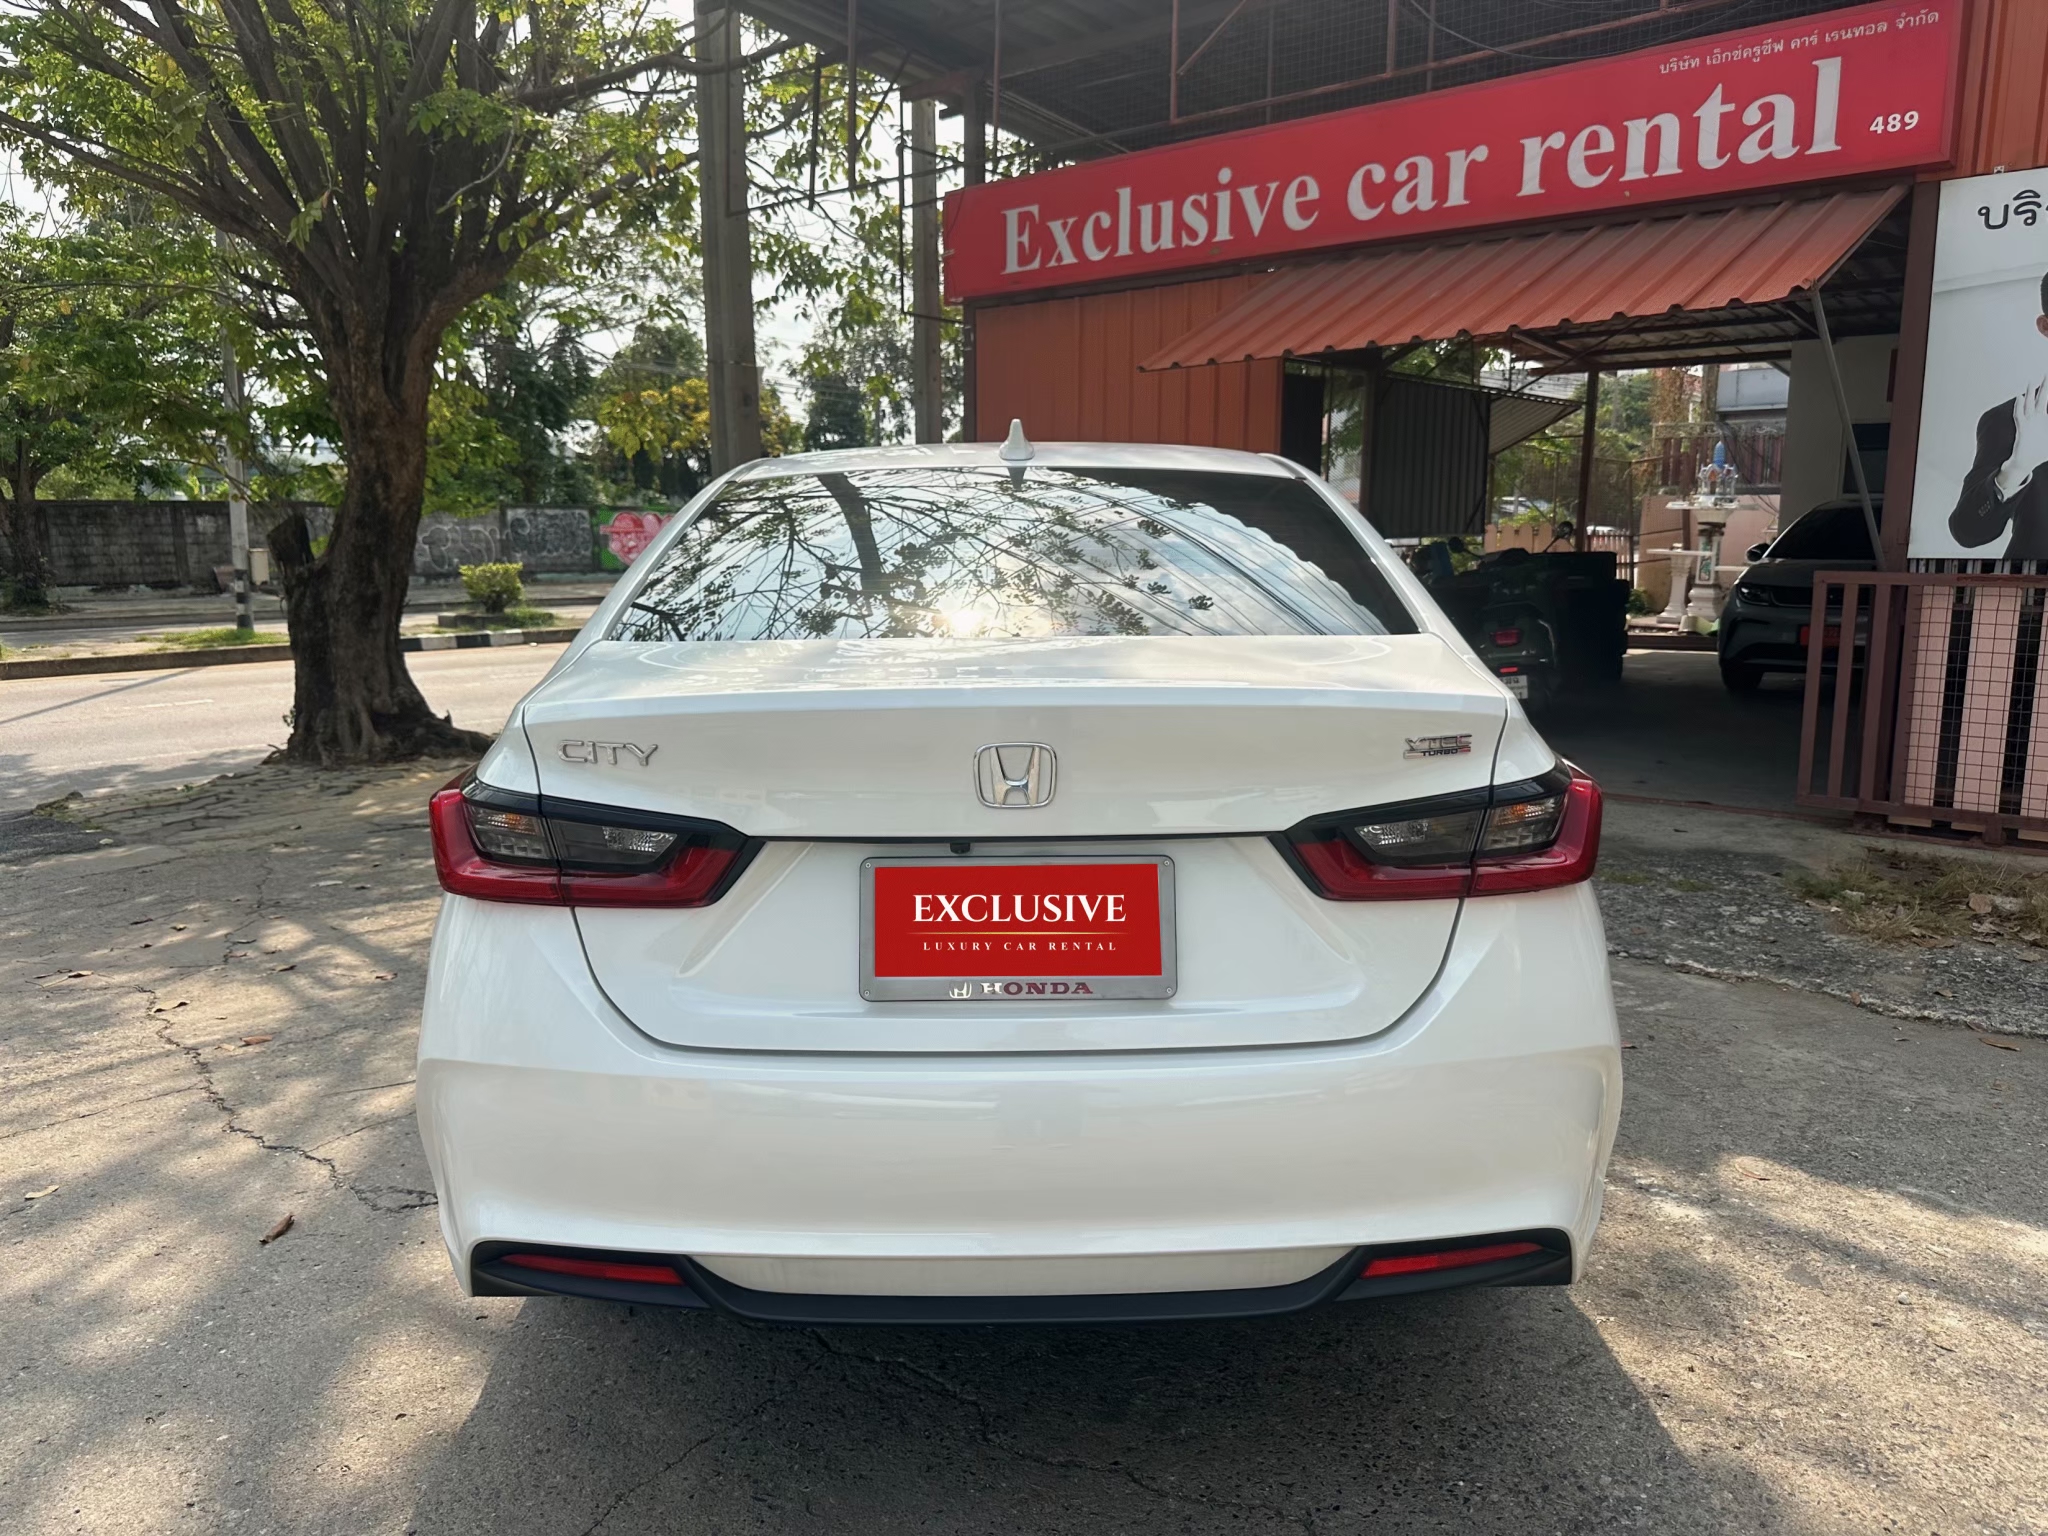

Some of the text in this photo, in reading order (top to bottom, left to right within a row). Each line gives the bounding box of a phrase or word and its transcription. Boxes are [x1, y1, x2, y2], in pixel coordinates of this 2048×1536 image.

[1659, 55, 1700, 74] บริษัท
[1790, 30, 1818, 50] คาร์
[1825, 21, 1888, 43] เรนทอล
[1896, 8, 1940, 30] จำกัด
[1869, 110, 1921, 136] 489
[1000, 56, 1843, 275] Exclusive car rental
[1977, 189, 2048, 230] บริ
[558, 739, 659, 766] CITY
[1421, 748, 1458, 756] TURBO
[979, 982, 1094, 995] HONDA
